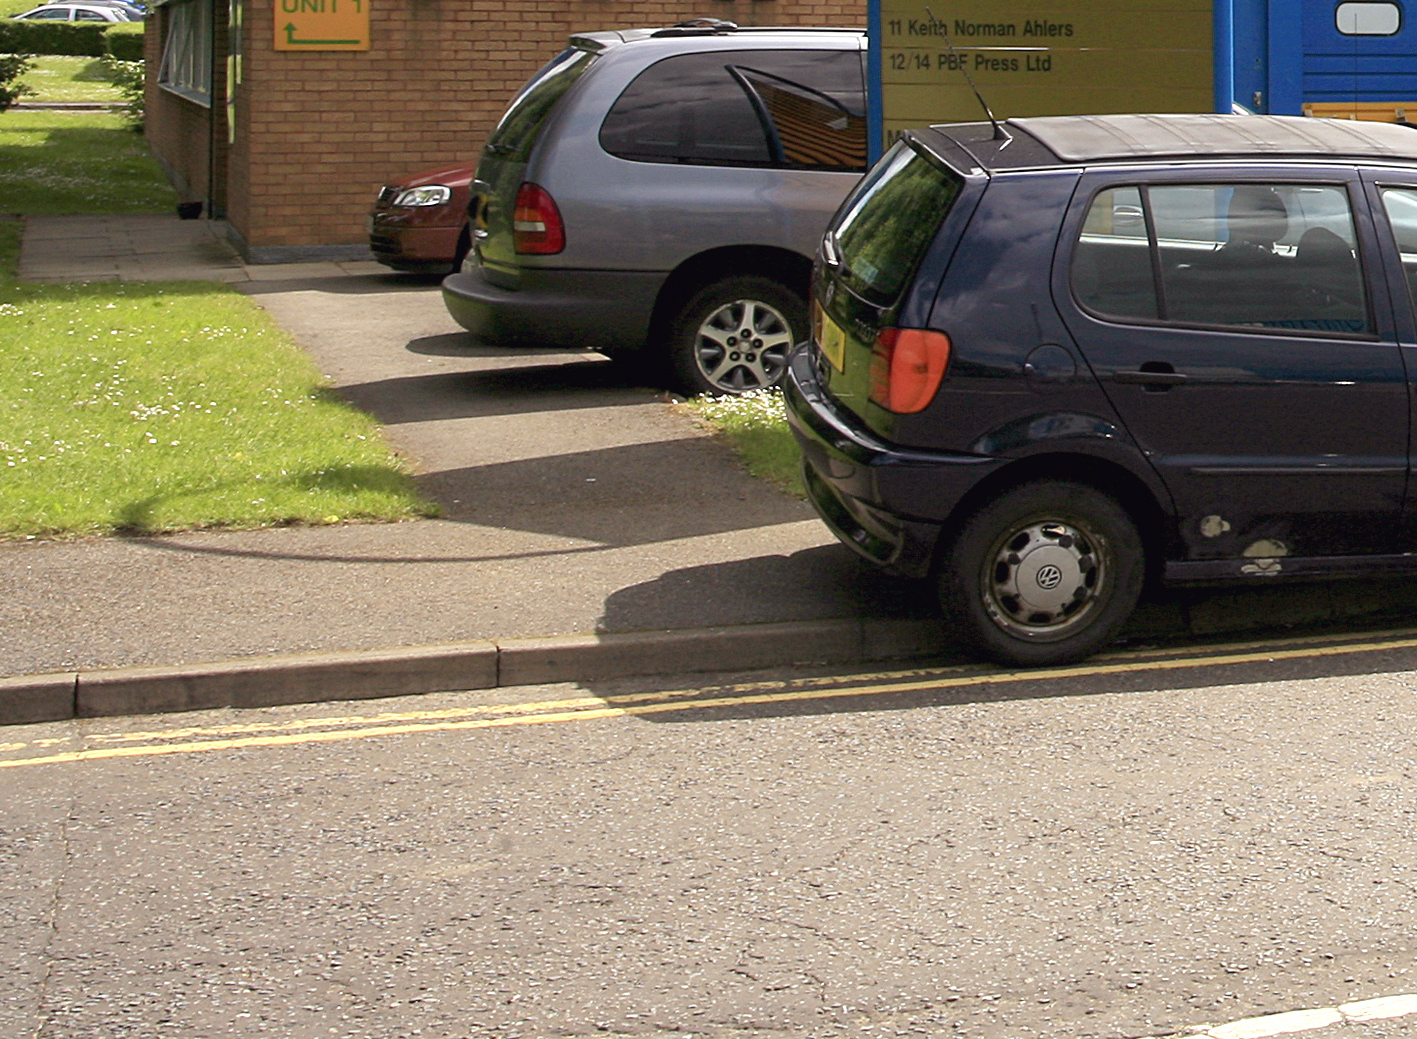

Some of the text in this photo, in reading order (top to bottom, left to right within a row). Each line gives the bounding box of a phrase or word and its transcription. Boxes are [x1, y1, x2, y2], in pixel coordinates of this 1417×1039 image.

[889, 19, 1073, 36] 11 Keith Norman Ahlers
[889, 53, 1051, 72] 12/14 PBF Press Ltd
